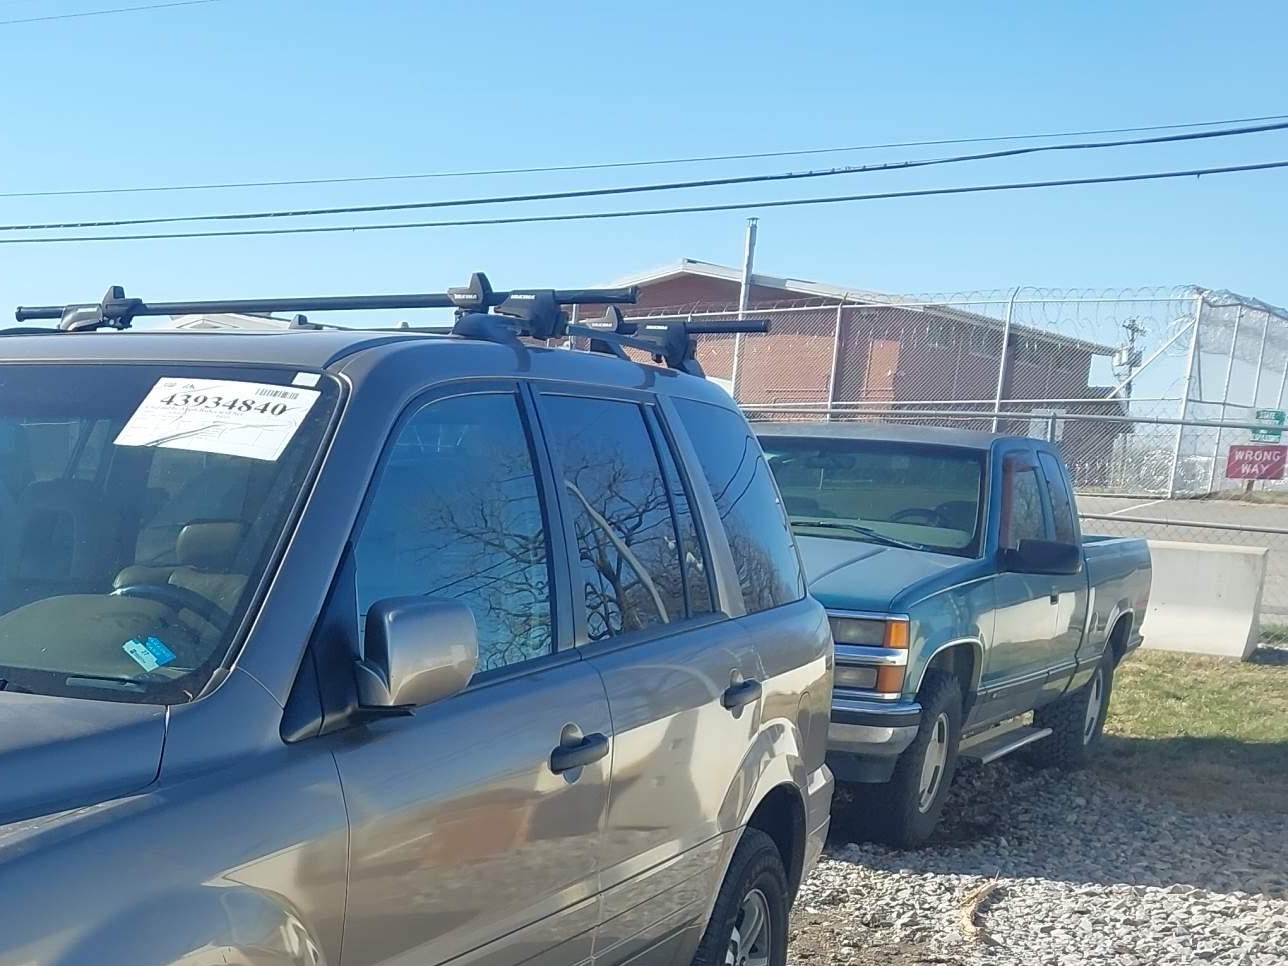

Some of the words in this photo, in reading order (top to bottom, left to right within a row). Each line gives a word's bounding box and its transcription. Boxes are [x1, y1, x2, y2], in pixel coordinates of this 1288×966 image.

[160, 393, 287, 416] 43934840
[1235, 450, 1281, 461] WRONG
[1241, 463, 1272, 474] WAY
